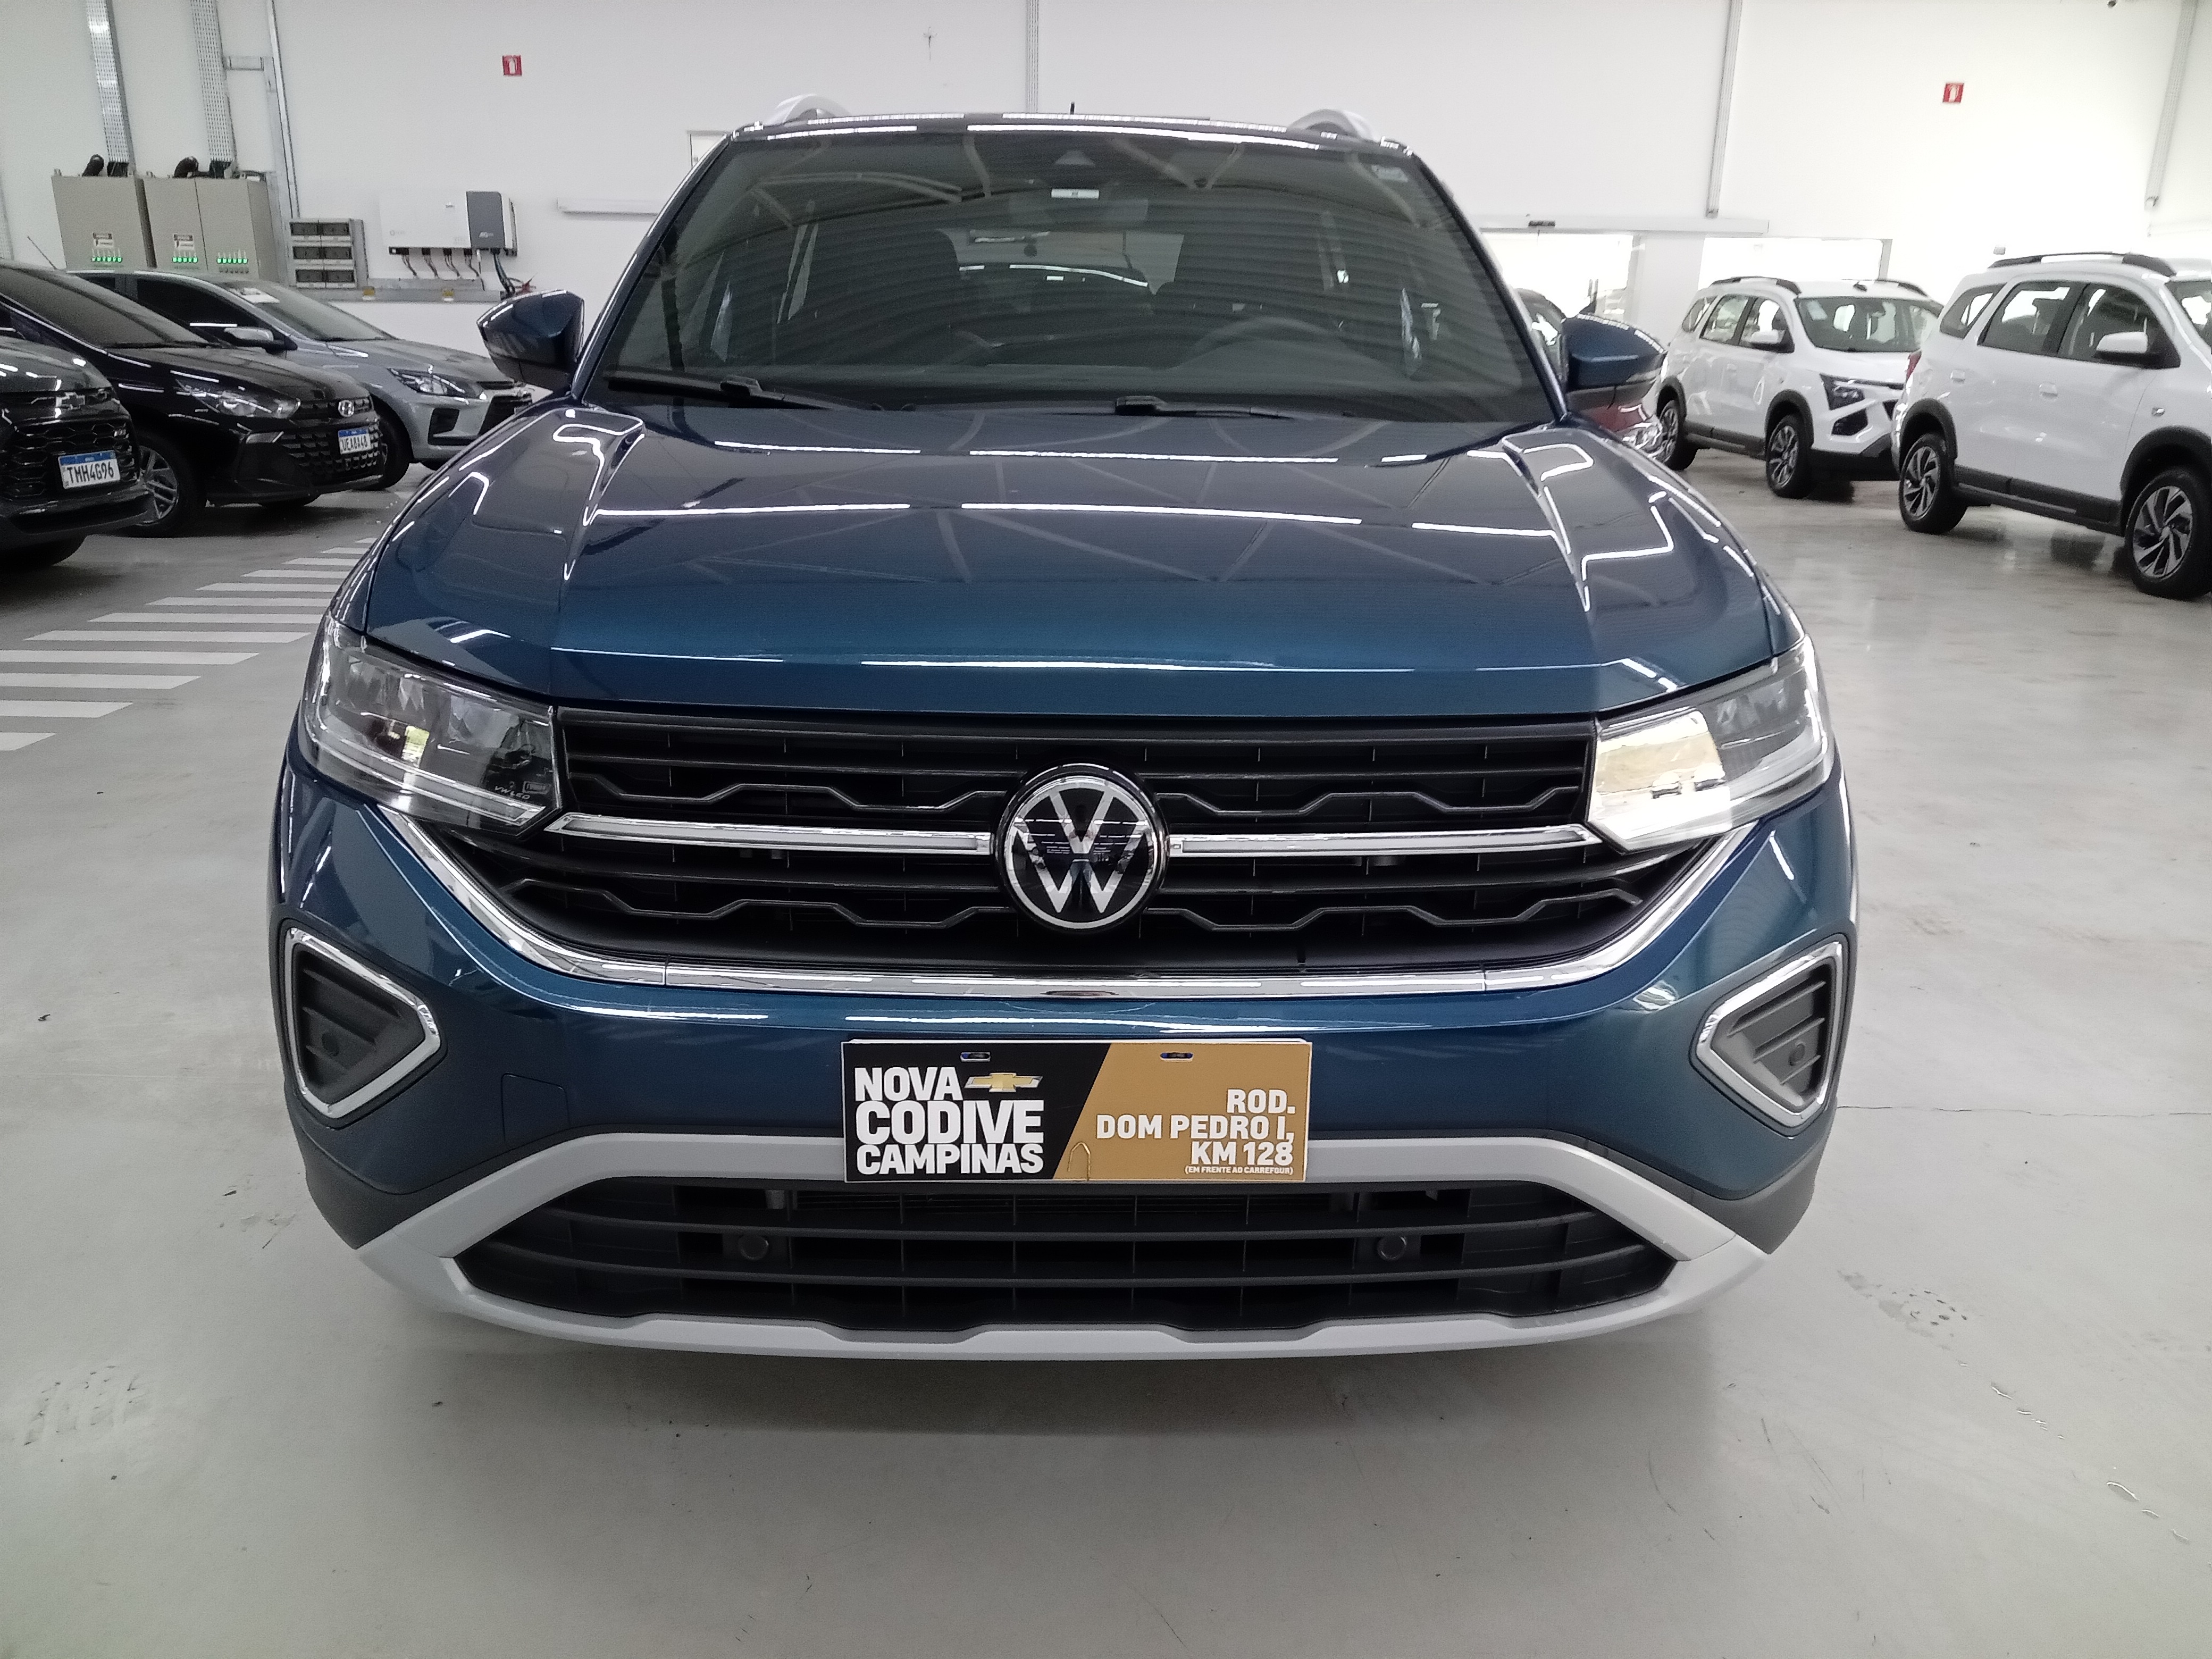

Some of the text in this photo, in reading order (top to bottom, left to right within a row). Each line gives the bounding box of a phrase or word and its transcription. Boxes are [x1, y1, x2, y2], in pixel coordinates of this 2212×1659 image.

[67, 462, 114, 483] TMH4G96
[854, 1067, 963, 1101] NOVA
[1227, 1088, 1295, 1113] ROD.
[856, 1100, 1044, 1144] CODIVE
[1096, 1115, 1294, 1144] DOM PEDRO I,
[857, 1143, 1043, 1175] CAMPINAS
[1191, 1141, 1293, 1166] KM 128
[1185, 1166, 1200, 1174] (EM
